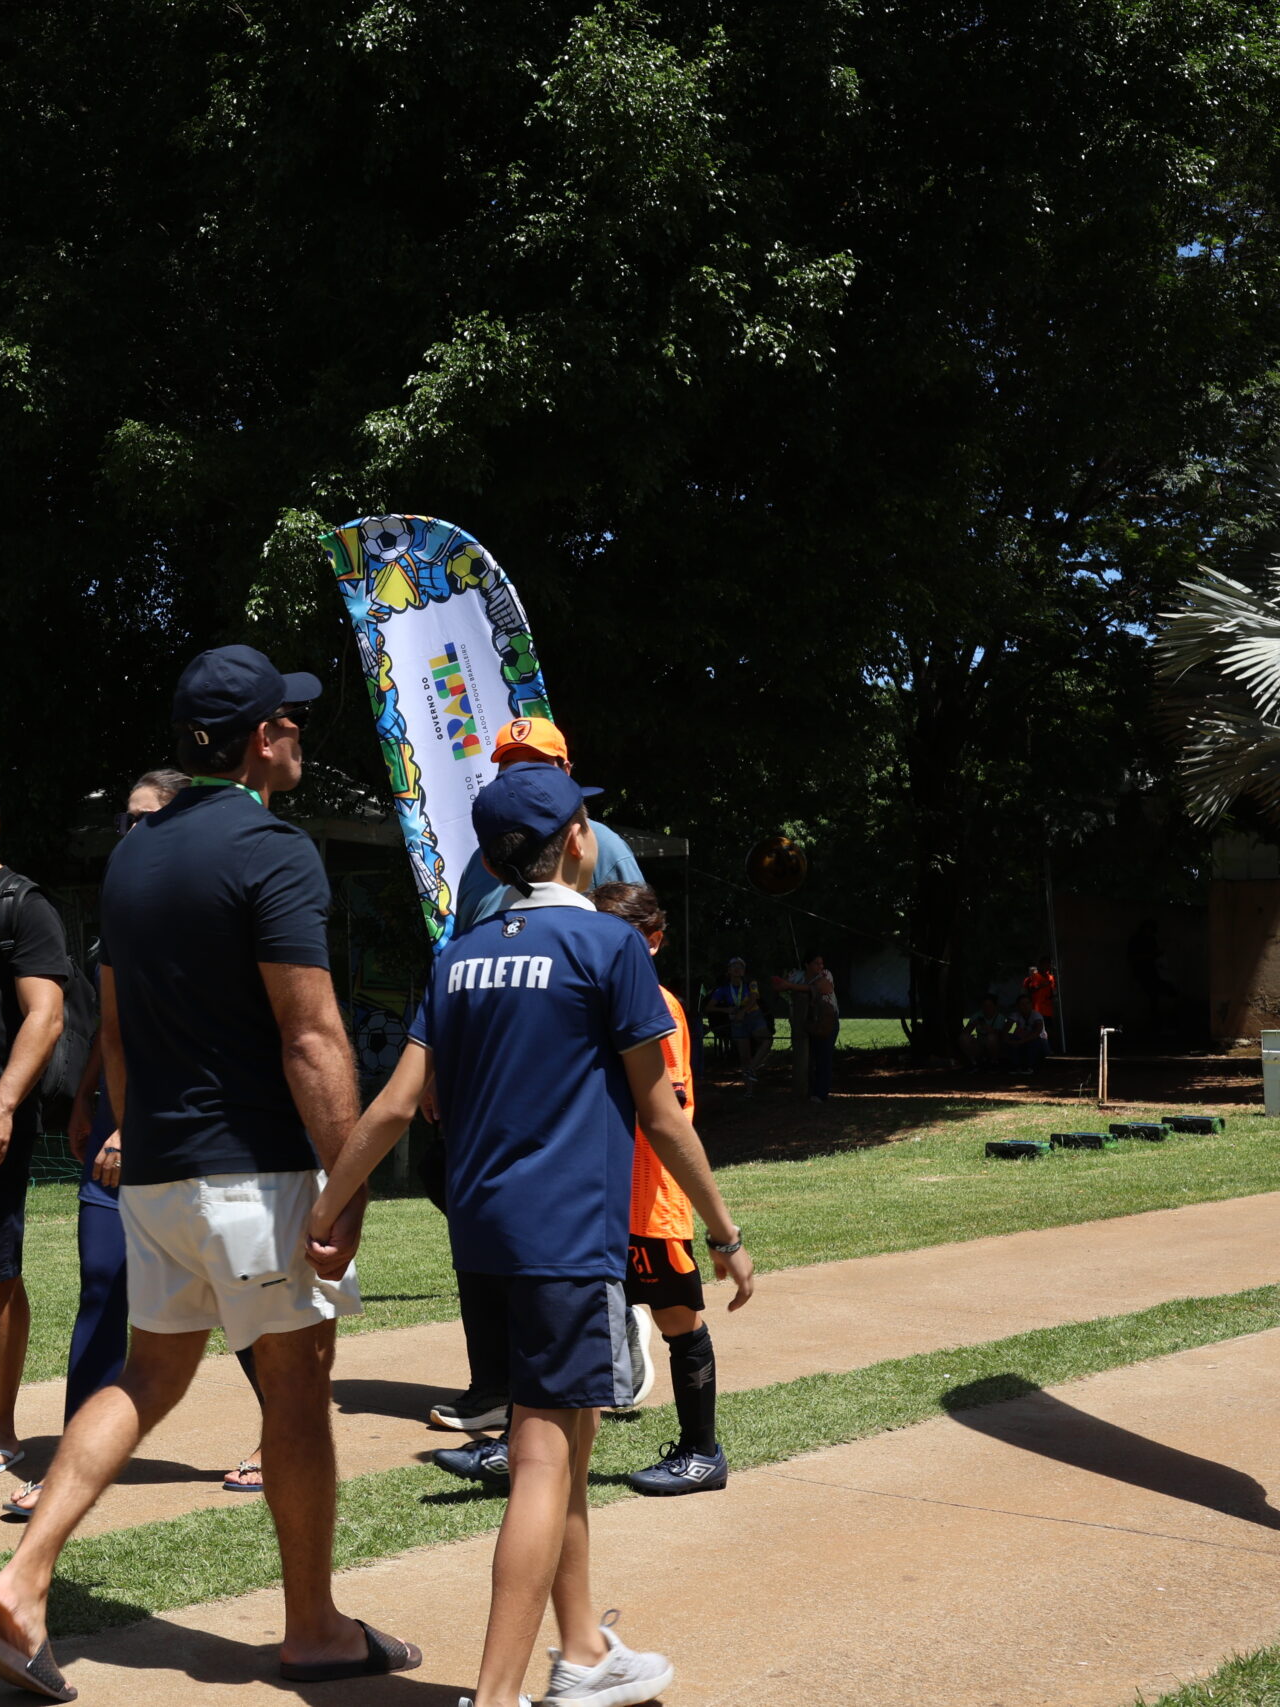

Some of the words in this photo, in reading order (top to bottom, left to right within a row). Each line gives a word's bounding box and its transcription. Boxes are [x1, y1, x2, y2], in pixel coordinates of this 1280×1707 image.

[460, 644, 475, 681] BRASILEIRO
[421, 676, 431, 691] DO
[471, 684, 480, 701] POVO
[428, 642, 483, 761] BRASIL
[476, 704, 483, 713] DO
[426, 695, 444, 741] GOVERNO
[480, 716, 489, 733] LADO
[484, 736, 491, 745] DO
[464, 776, 474, 790] DO
[447, 955, 554, 994] ATLETA
